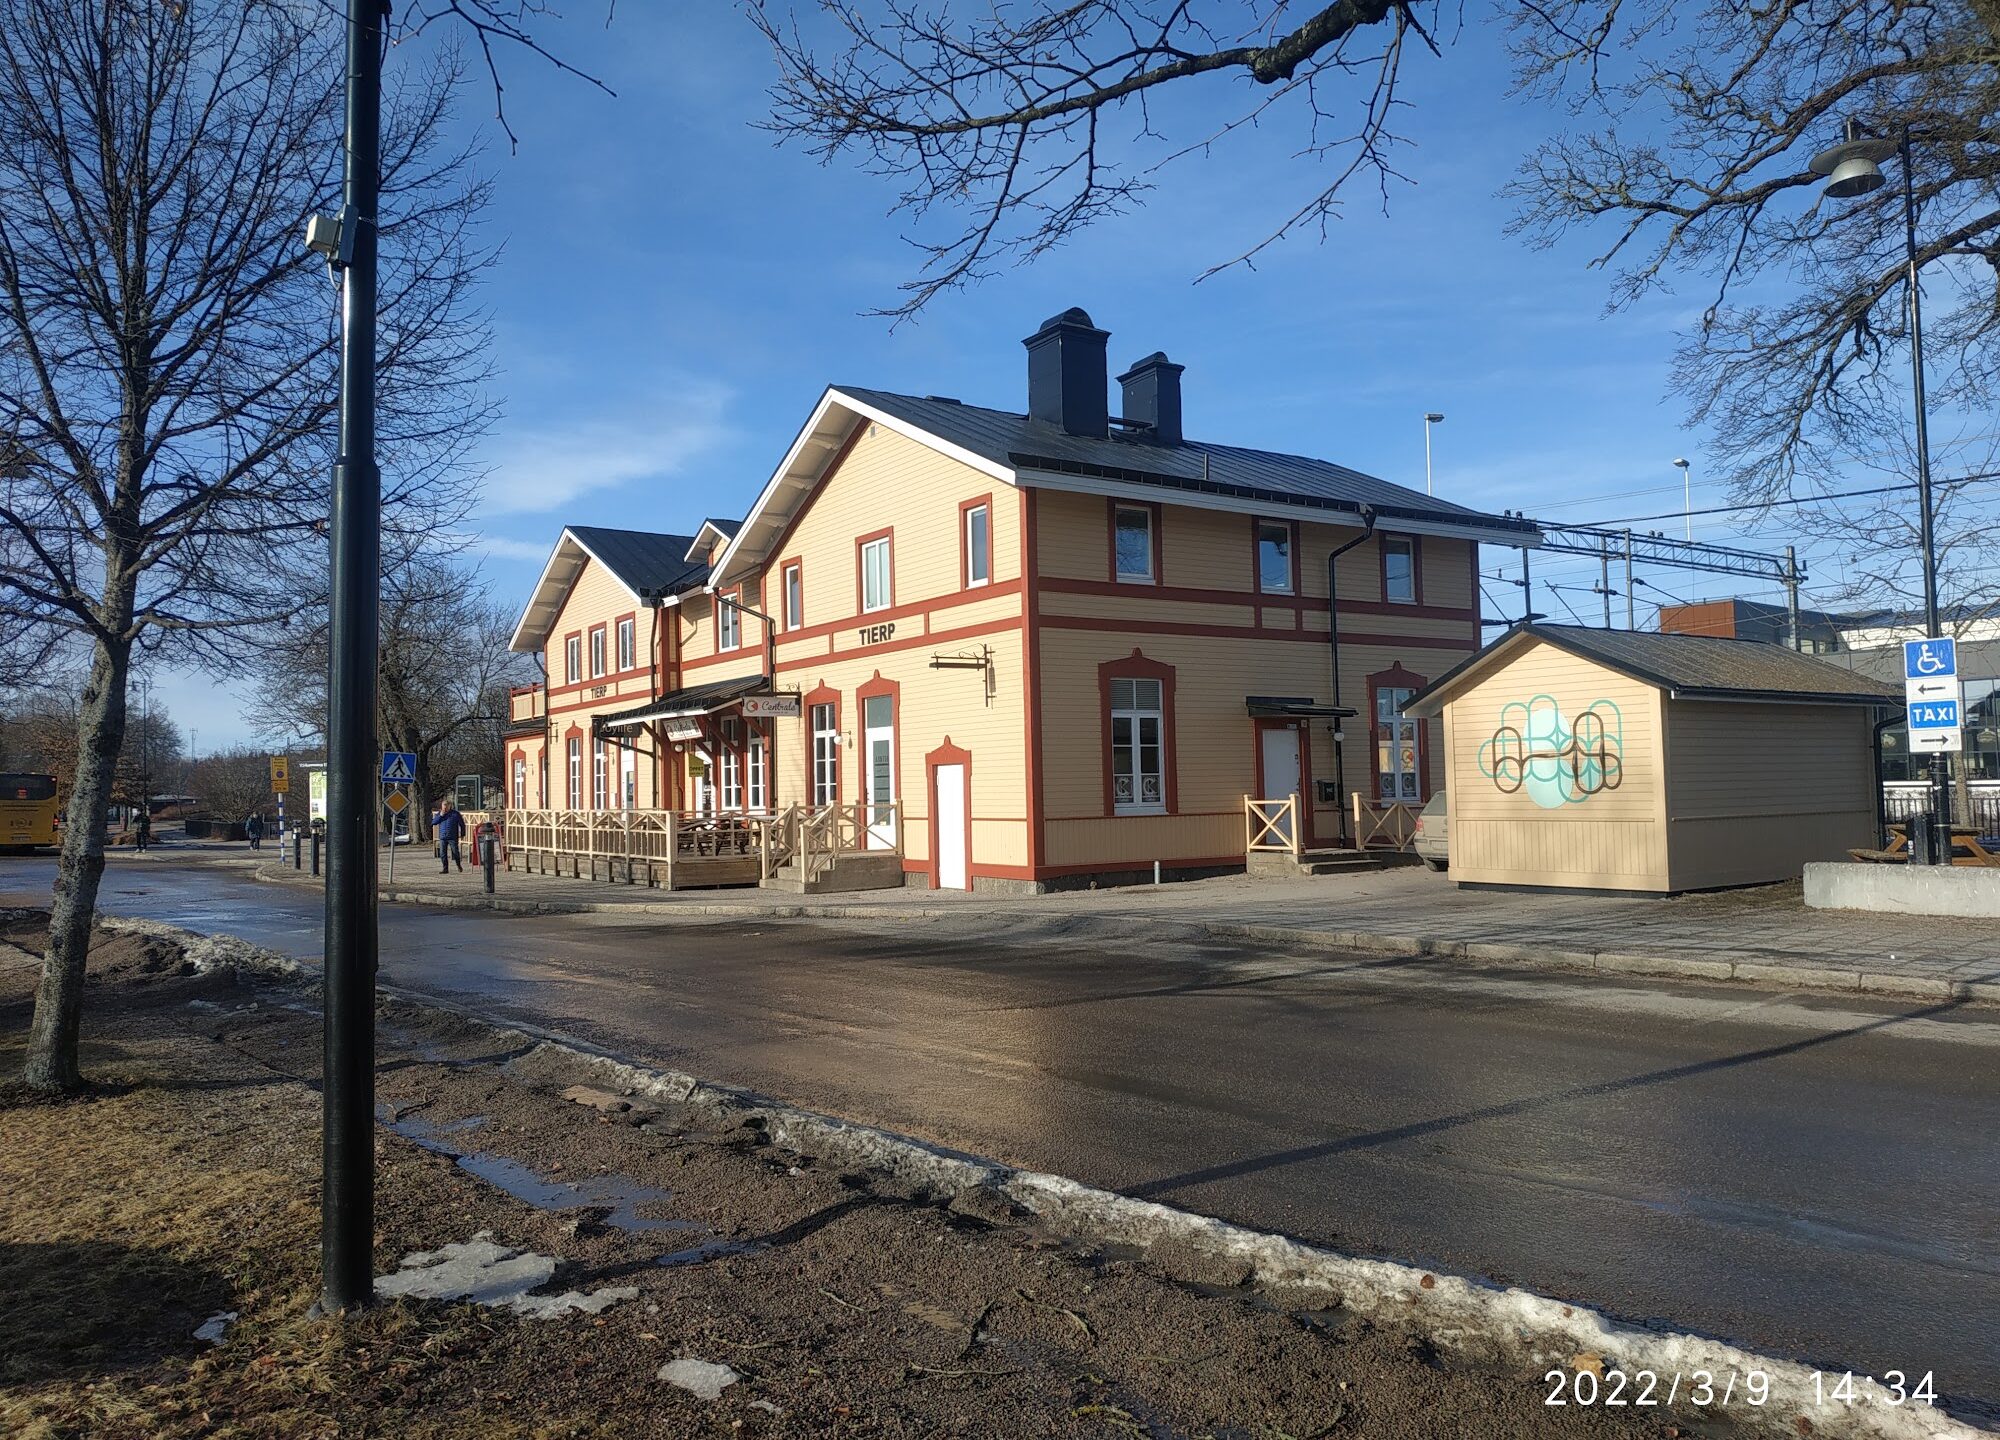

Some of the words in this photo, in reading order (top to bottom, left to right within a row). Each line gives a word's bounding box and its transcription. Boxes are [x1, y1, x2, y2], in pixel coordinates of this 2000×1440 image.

[859, 623, 895, 645] TIERP
[591, 685, 607, 699] TIERP
[761, 701, 796, 711] Centrale
[1913, 706, 1954, 722] TAXI
